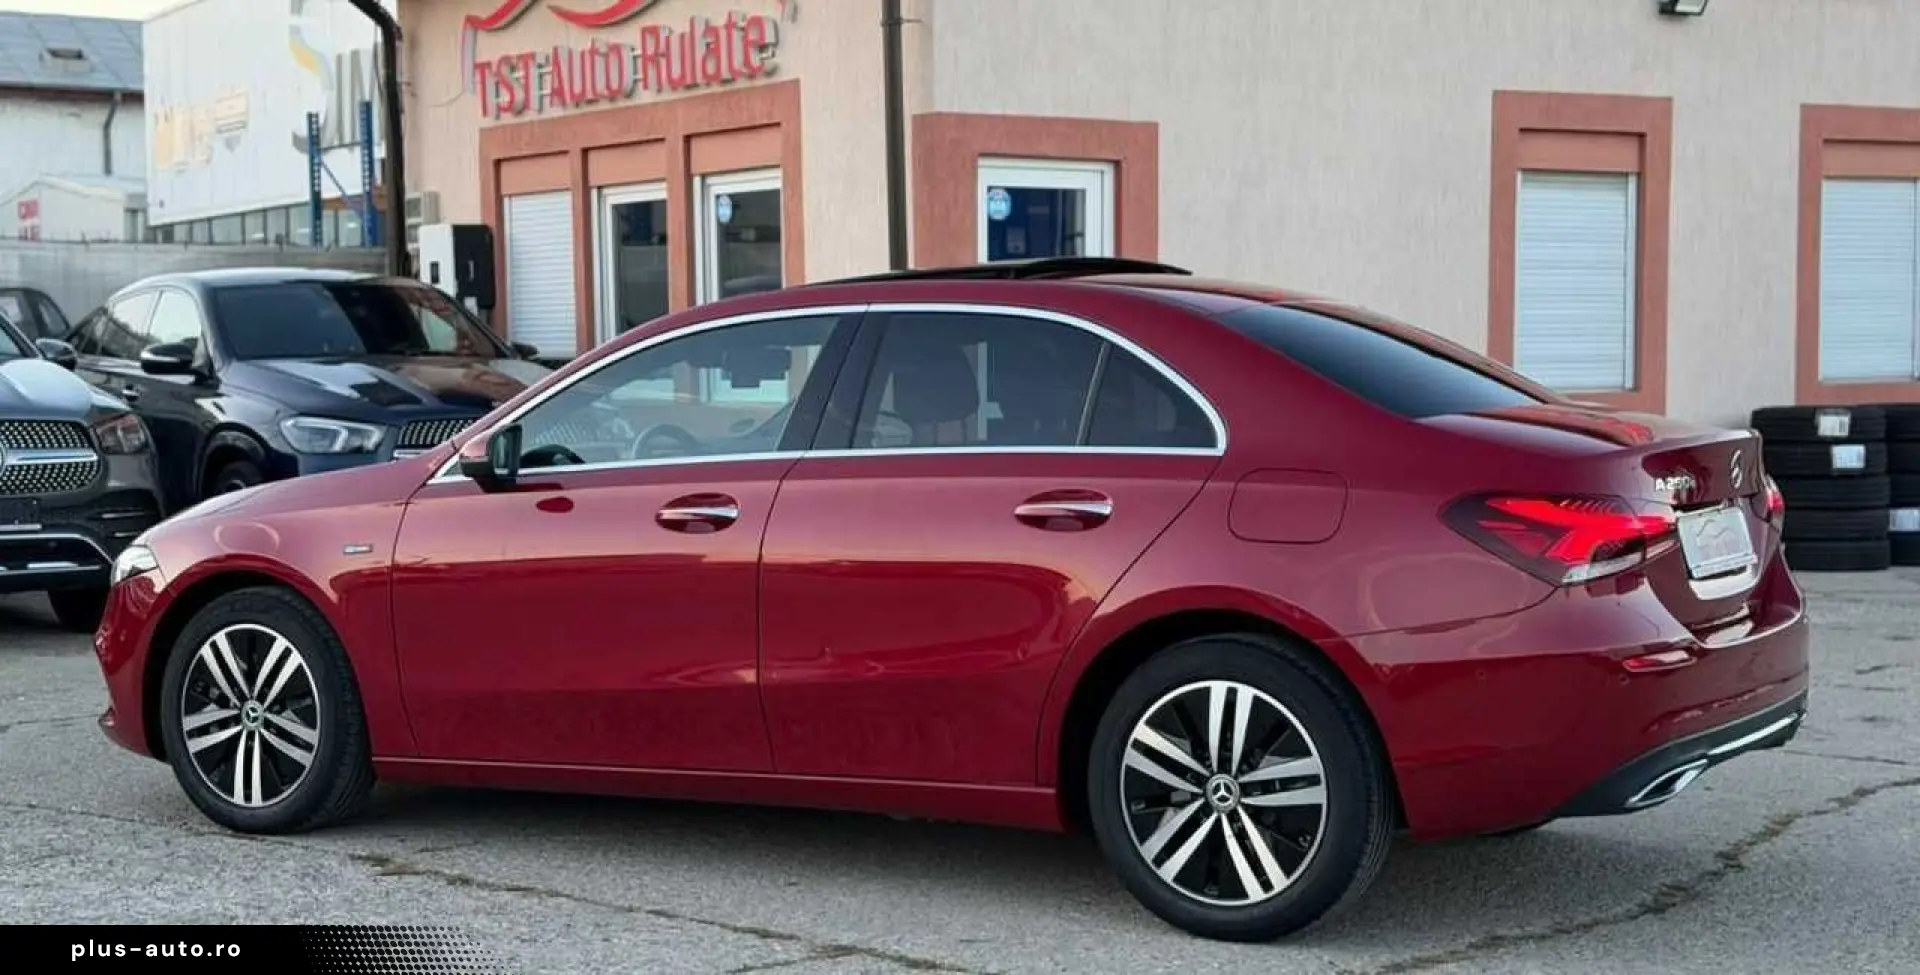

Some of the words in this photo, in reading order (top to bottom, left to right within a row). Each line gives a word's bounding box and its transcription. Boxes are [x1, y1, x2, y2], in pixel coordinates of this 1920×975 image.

[473, 52, 540, 117] TST
[549, 38, 627, 108] Auto
[641, 12, 771, 93] Rulate
[1655, 478, 1665, 491] A
